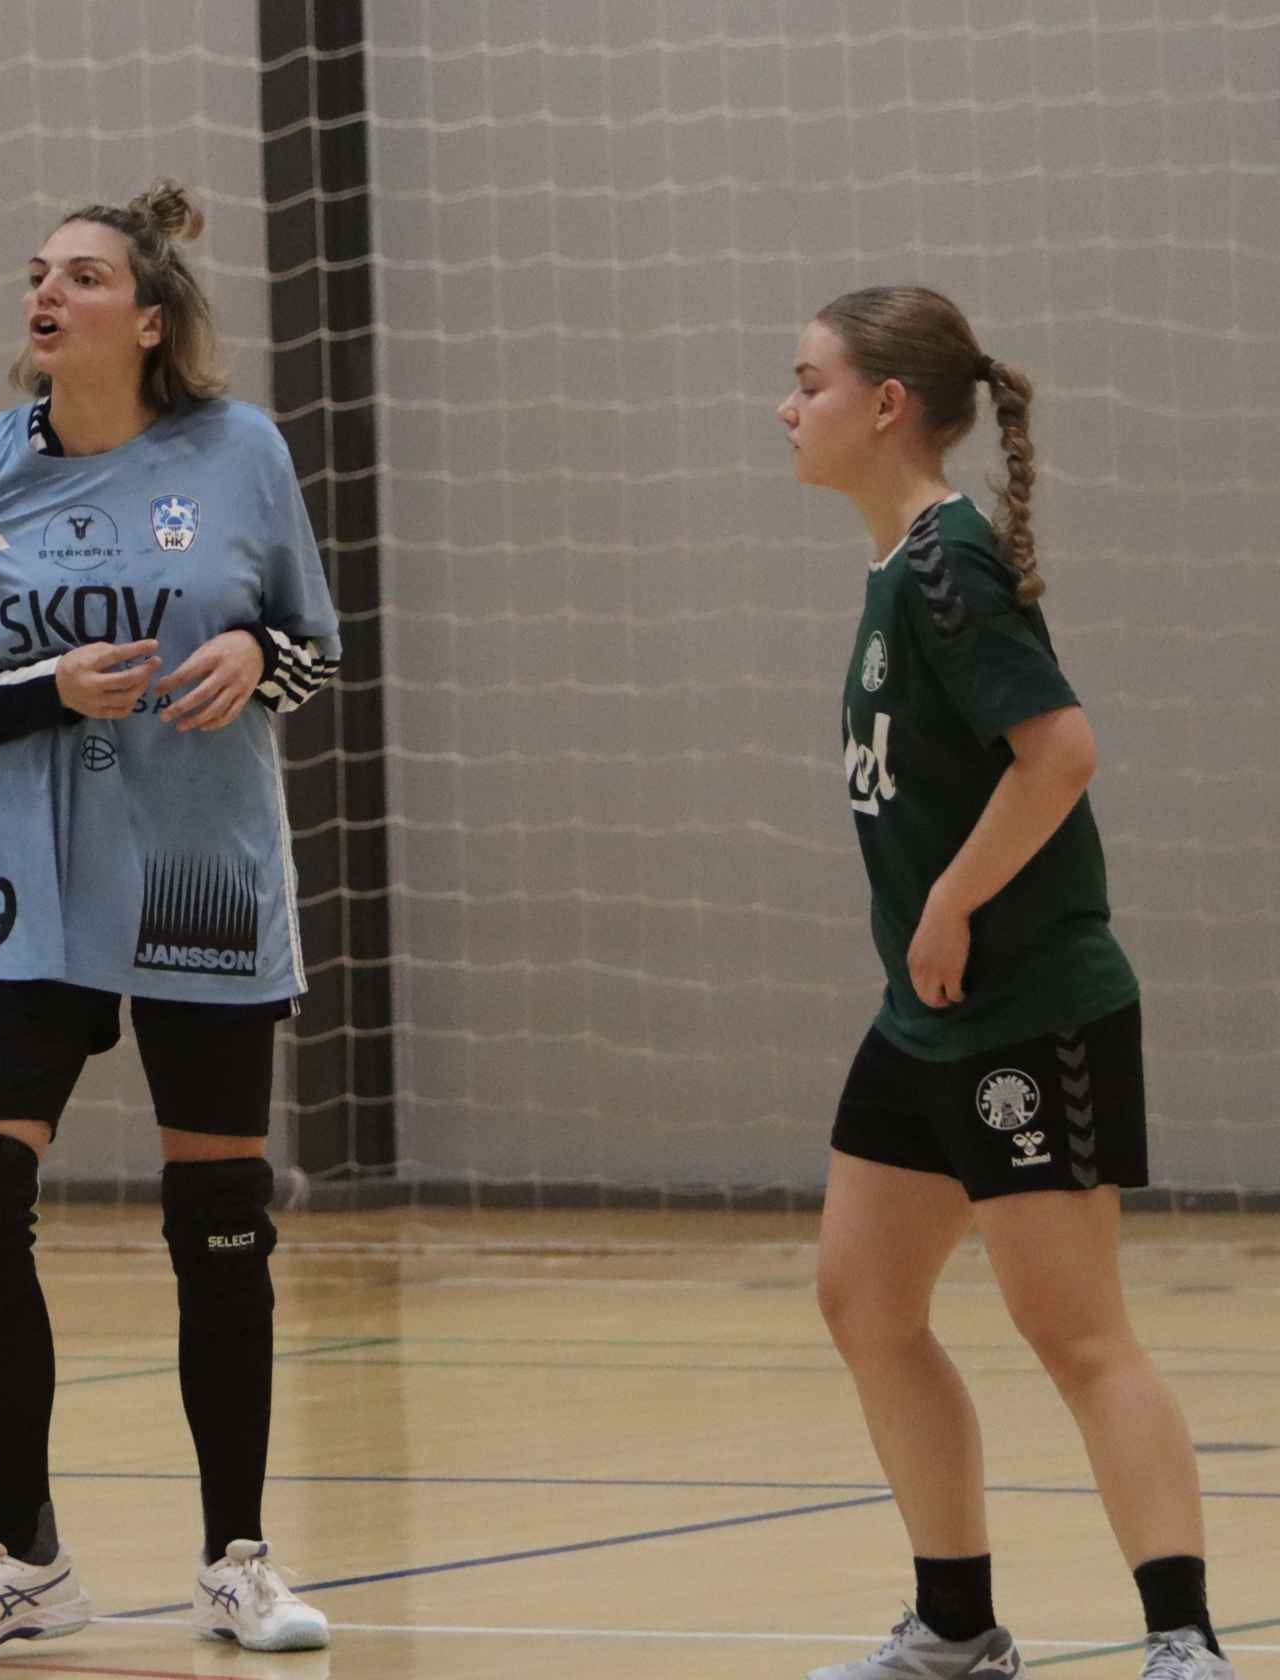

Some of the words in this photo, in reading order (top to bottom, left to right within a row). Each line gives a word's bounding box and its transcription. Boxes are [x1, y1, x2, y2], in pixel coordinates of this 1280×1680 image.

[0, 585, 171, 655] SKOV
[137, 943, 255, 971] JANSSON
[208, 1232, 255, 1248] SELECT
